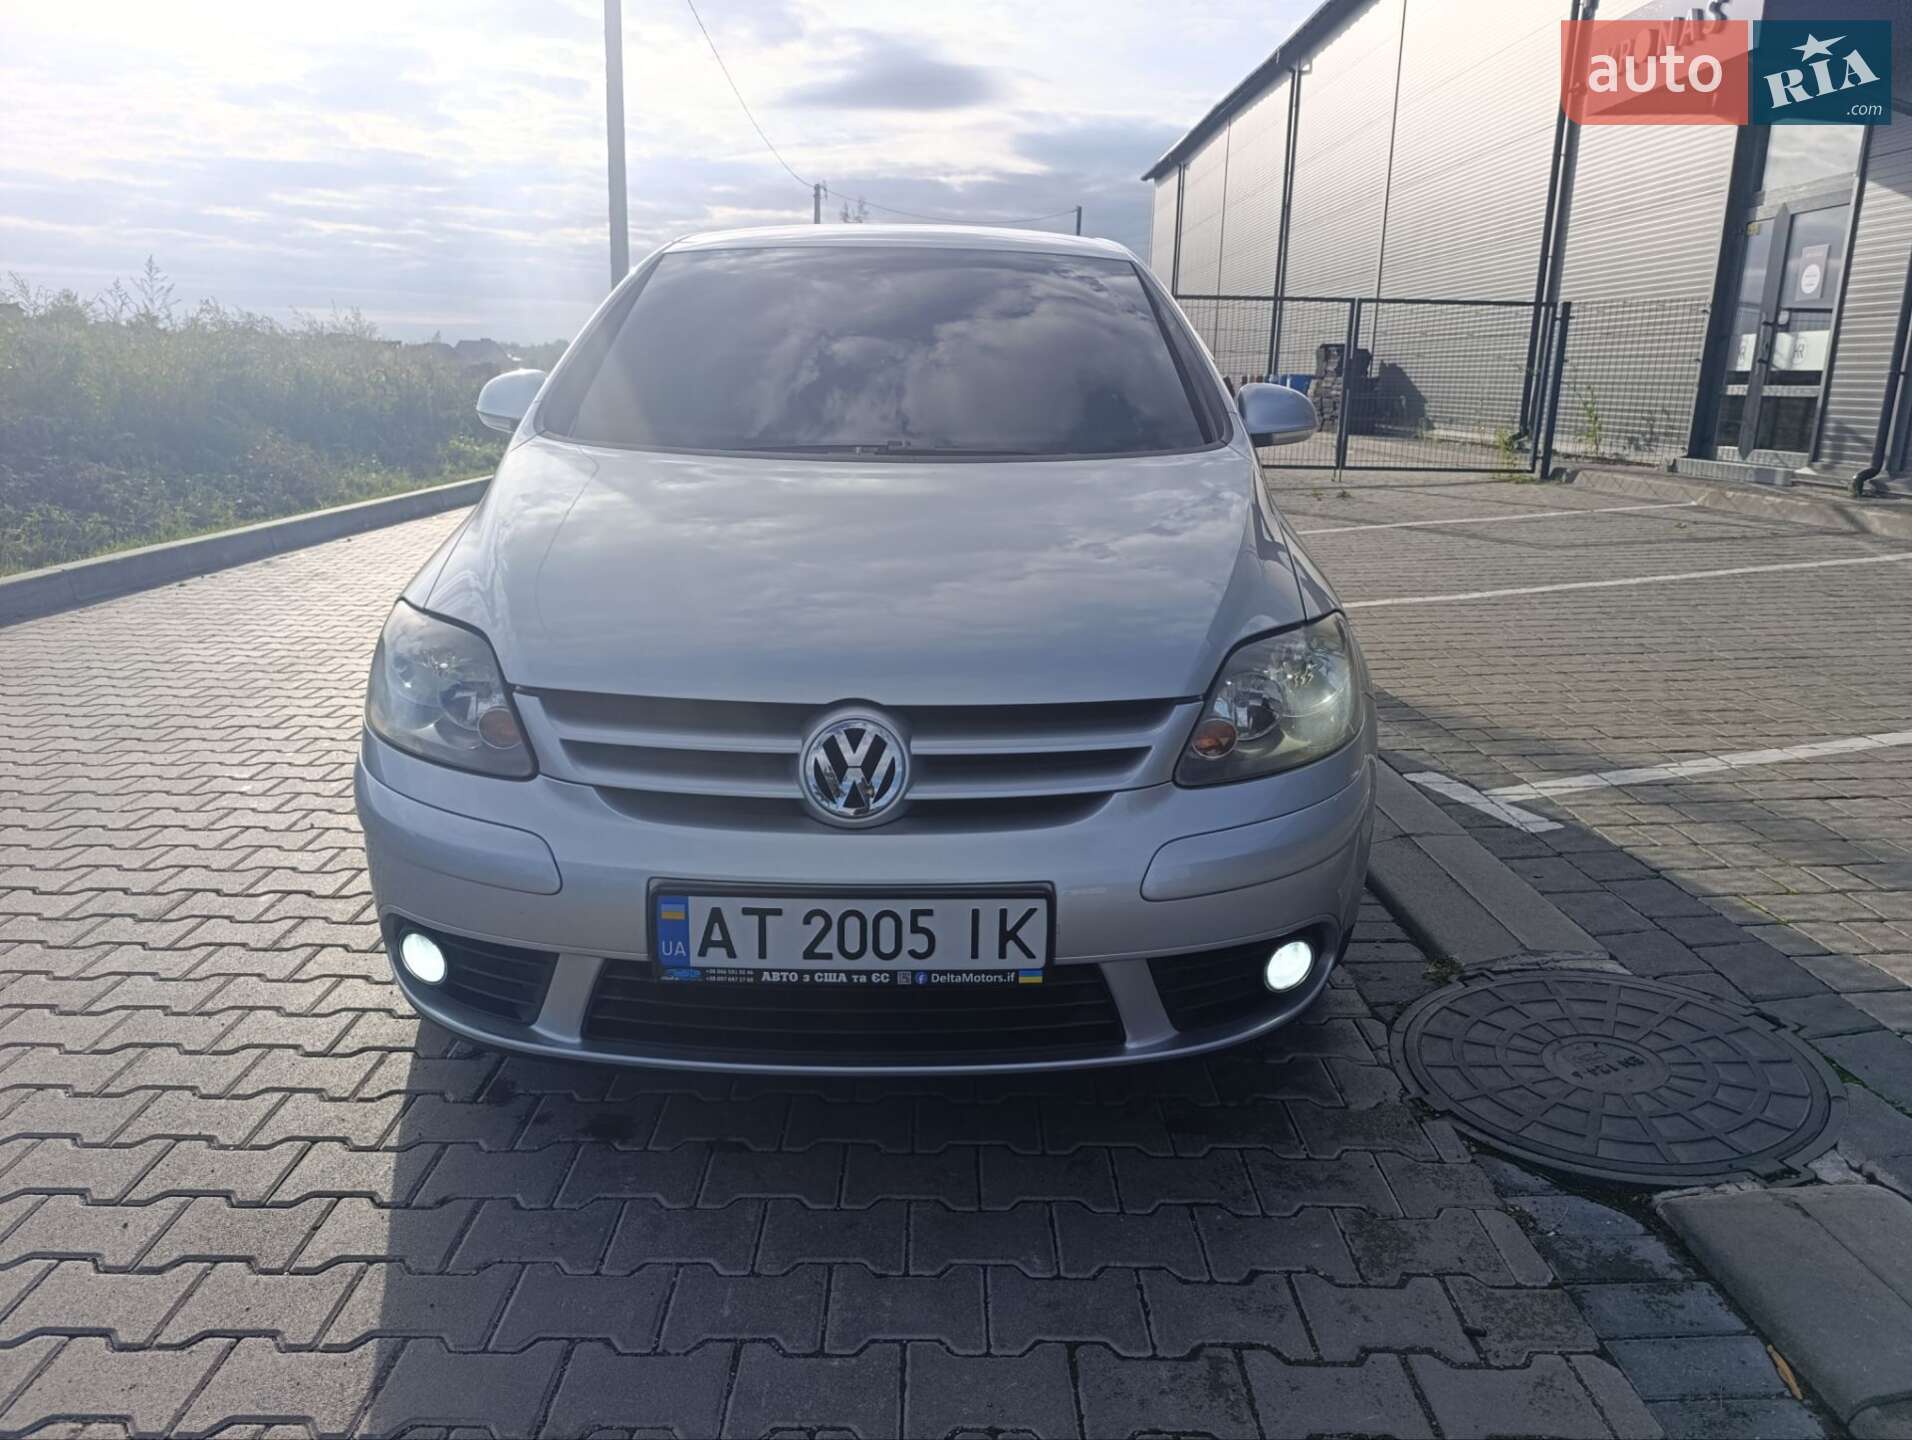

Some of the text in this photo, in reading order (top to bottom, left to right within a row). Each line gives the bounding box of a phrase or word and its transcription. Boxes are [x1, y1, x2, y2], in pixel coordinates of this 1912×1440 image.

[697, 907, 1038, 961] AT 2005 IK
[662, 941, 687, 957] UA
[761, 971, 799, 983] АВТО
[814, 971, 848, 983] США
[852, 974, 868, 983] та
[931, 972, 1016, 984] DeltaMotors.if
